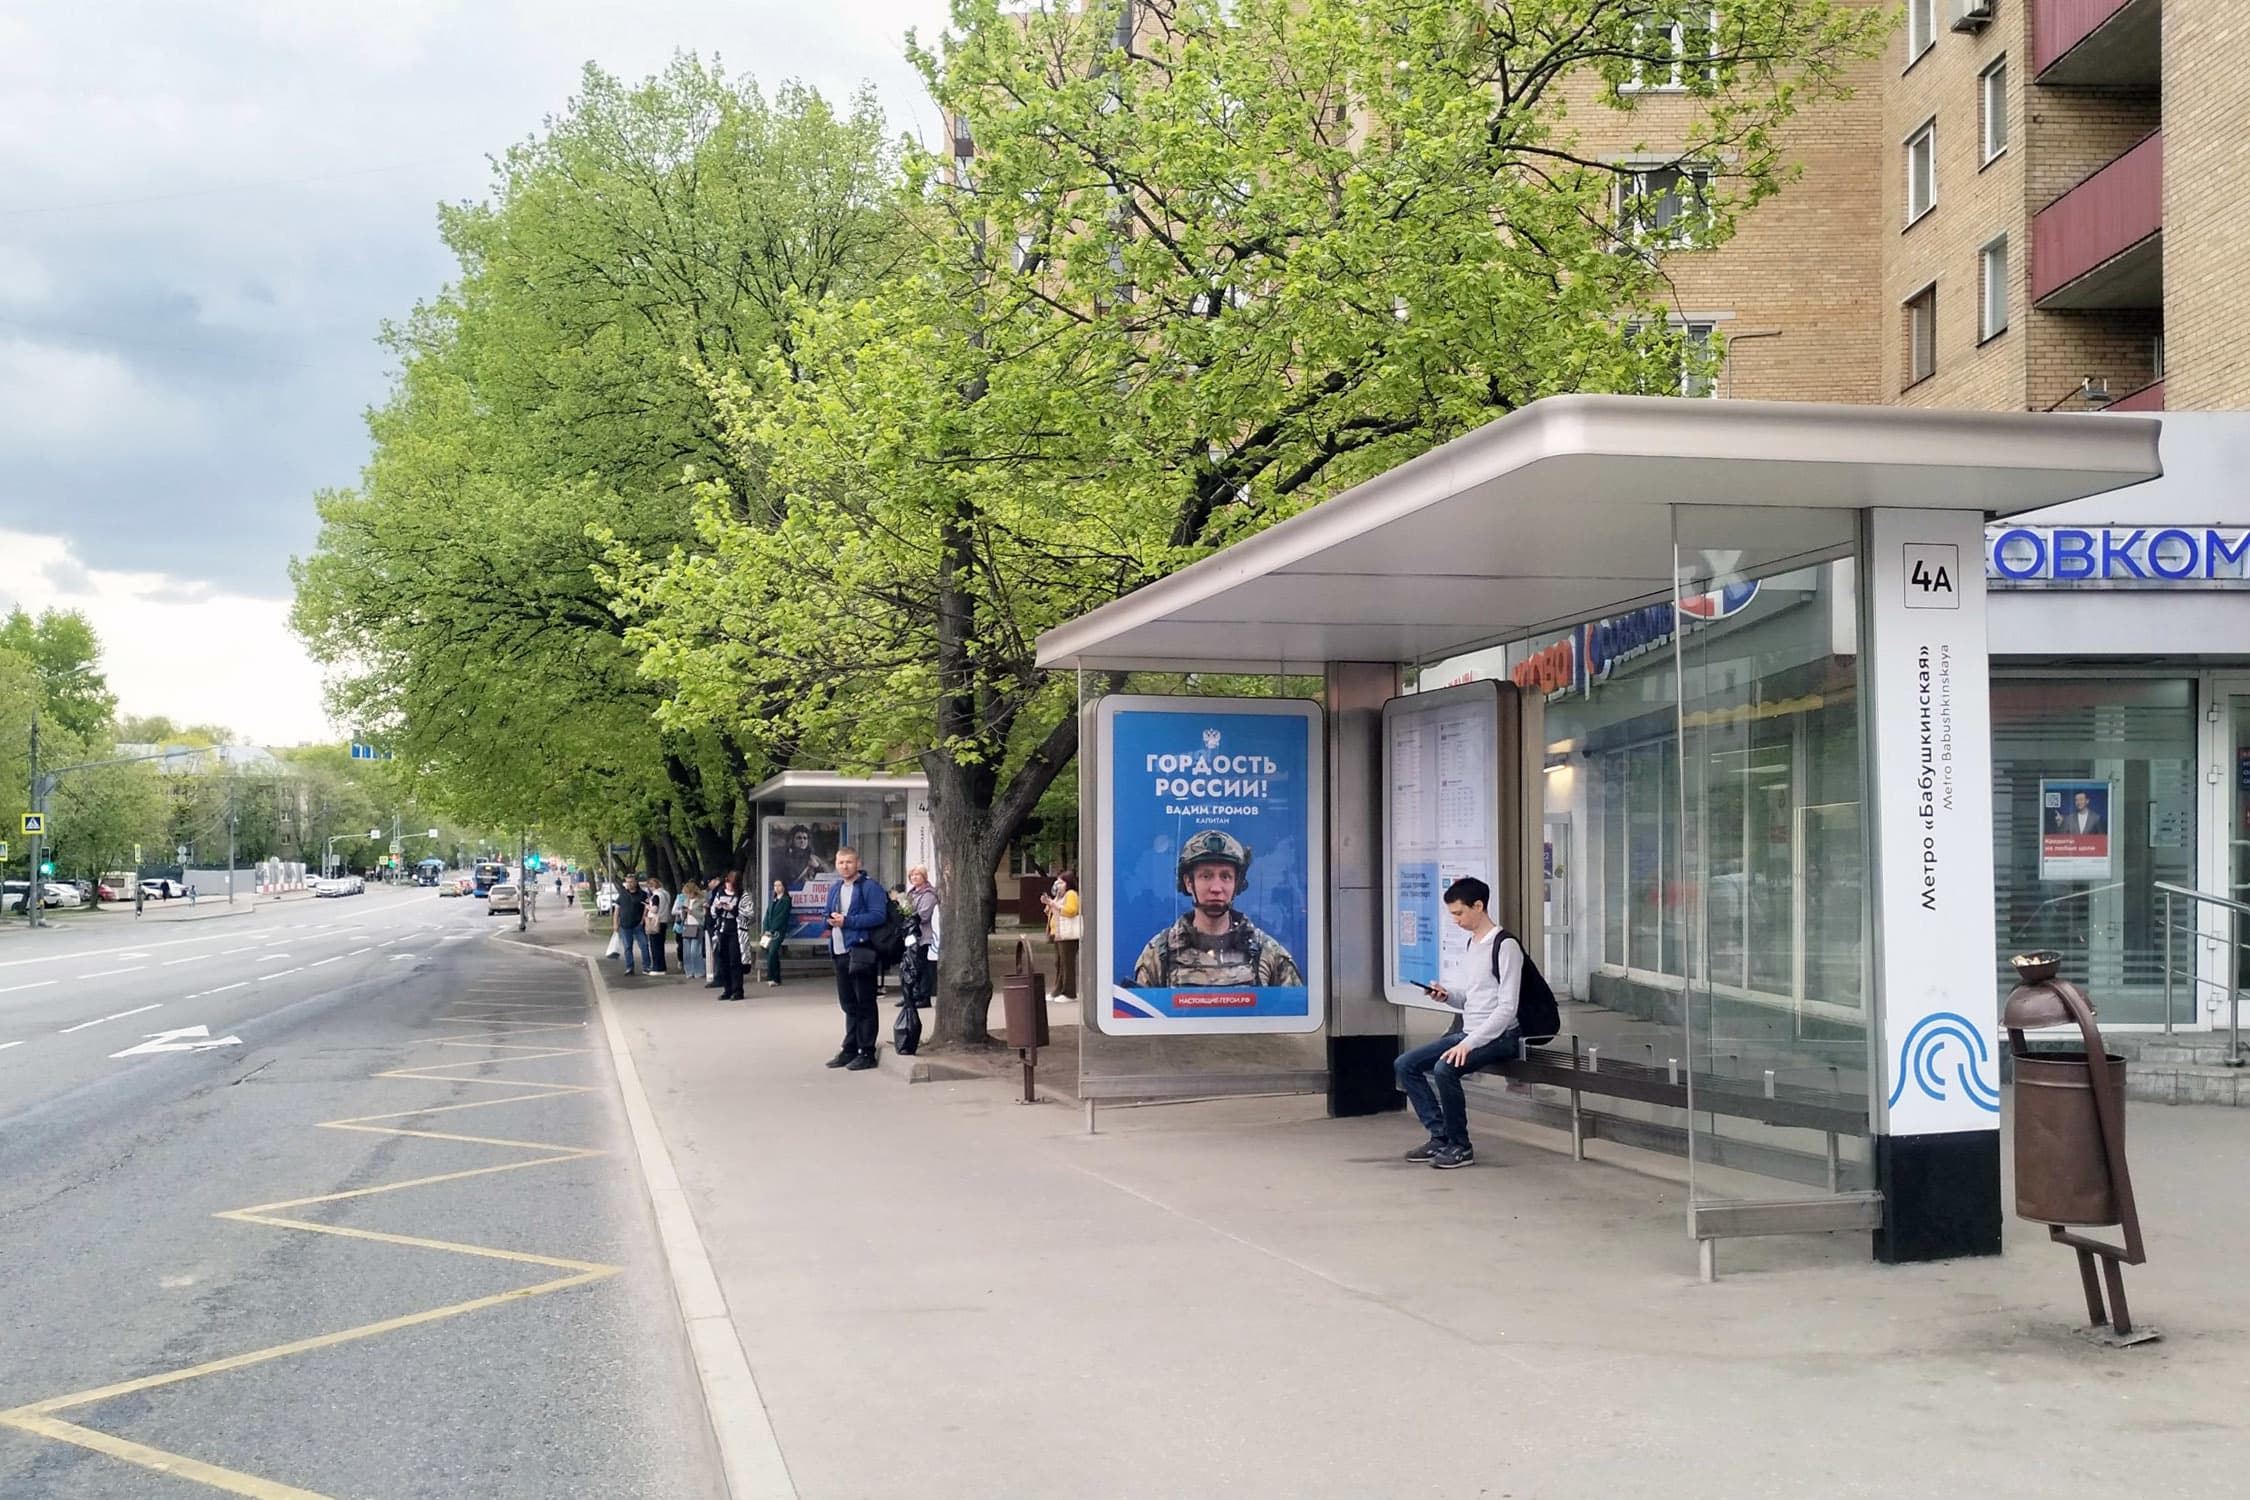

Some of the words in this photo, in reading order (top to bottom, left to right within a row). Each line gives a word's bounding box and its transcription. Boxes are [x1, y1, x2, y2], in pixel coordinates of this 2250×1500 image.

[1985, 529, 2250, 579] ОВКОМ
[1940, 644, 1952, 761] Babushkinskaya
[1918, 646, 1936, 831] «Бабушкинская»
[1146, 754, 1277, 775] ГОРДОСТЬ
[1155, 778, 1268, 800] РОССИИ!
[1942, 765, 1953, 810] Metro
[1166, 805, 1209, 816] ВАДИМ
[1212, 806, 1259, 816] ГРОМОВ
[1195, 817, 1230, 825] КАПИТАН
[1921, 836, 1937, 911] Метро
